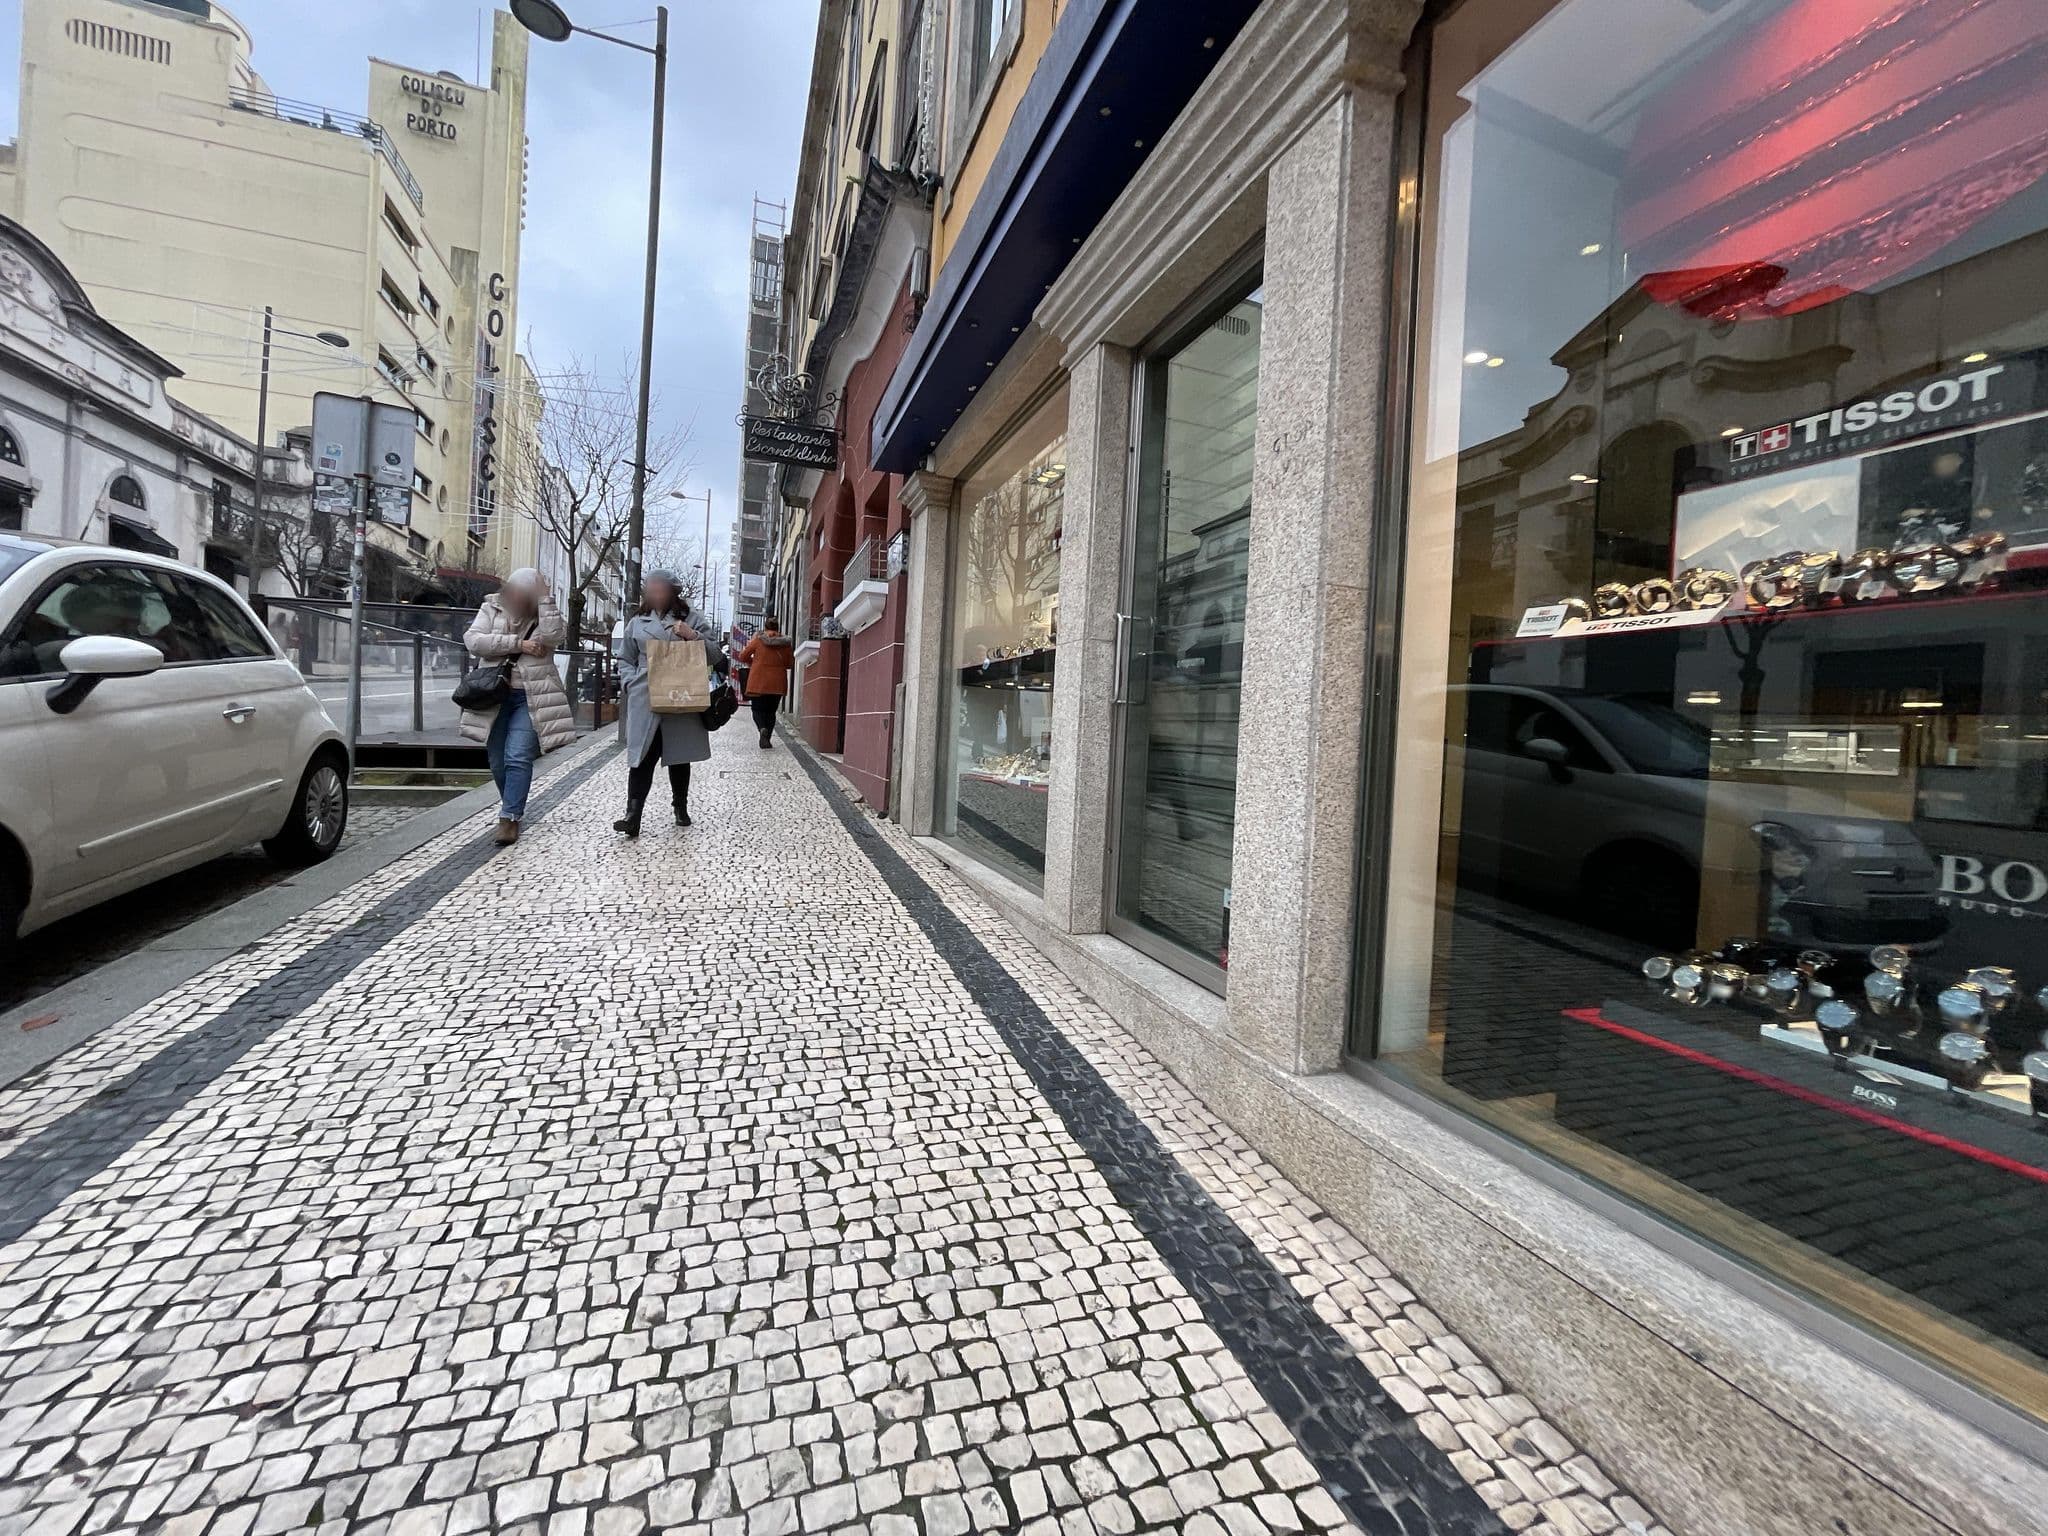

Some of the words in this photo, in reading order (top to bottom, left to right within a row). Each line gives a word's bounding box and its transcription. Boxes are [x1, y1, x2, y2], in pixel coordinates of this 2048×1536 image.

[401, 75, 465, 105] COLISEU
[421, 98, 443, 117] DO
[406, 113, 457, 140] PORTO
[1794, 365, 2005, 443] TISSOT
[751, 420, 832, 447] Restaurante
[1789, 433, 1871, 461] WATCHES
[1883, 417, 1942, 438] SINCE
[1611, 616, 1677, 629] TISSOT
[1852, 1085, 1897, 1107] BOSS
